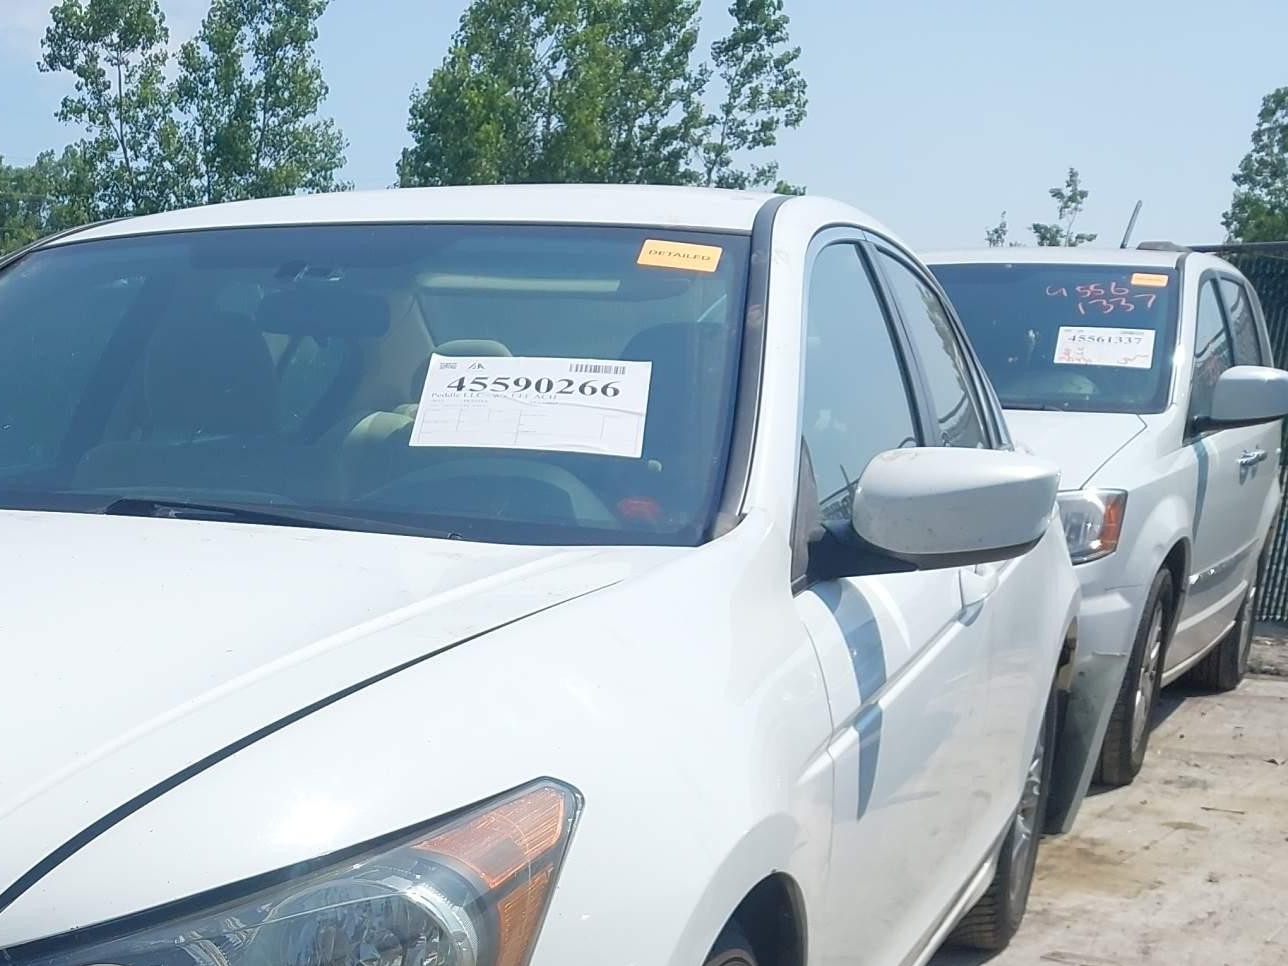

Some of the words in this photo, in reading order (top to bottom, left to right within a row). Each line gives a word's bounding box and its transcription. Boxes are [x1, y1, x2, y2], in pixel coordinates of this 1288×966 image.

[648, 249, 711, 261] DETAILED
[1078, 293, 1156, 314] 1337
[1068, 334, 1143, 345] 45561337
[446, 375, 621, 398] 45590266
